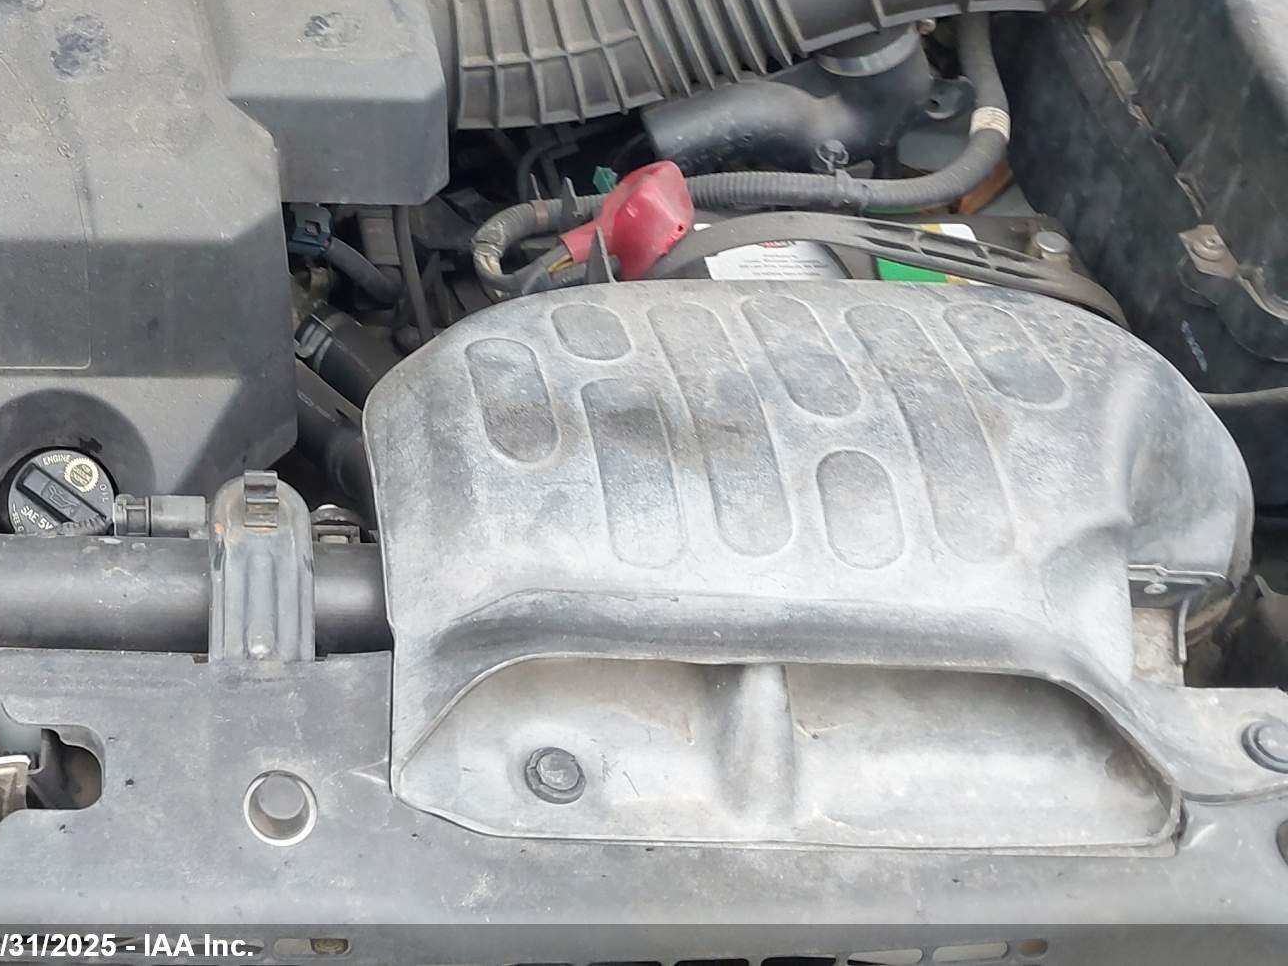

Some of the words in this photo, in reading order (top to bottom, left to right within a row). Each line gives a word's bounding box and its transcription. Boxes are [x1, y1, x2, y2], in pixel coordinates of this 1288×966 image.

[42, 454, 71, 466] ENGINE
[99, 484, 110, 503] OIL
[20, 505, 40, 524] SAE
